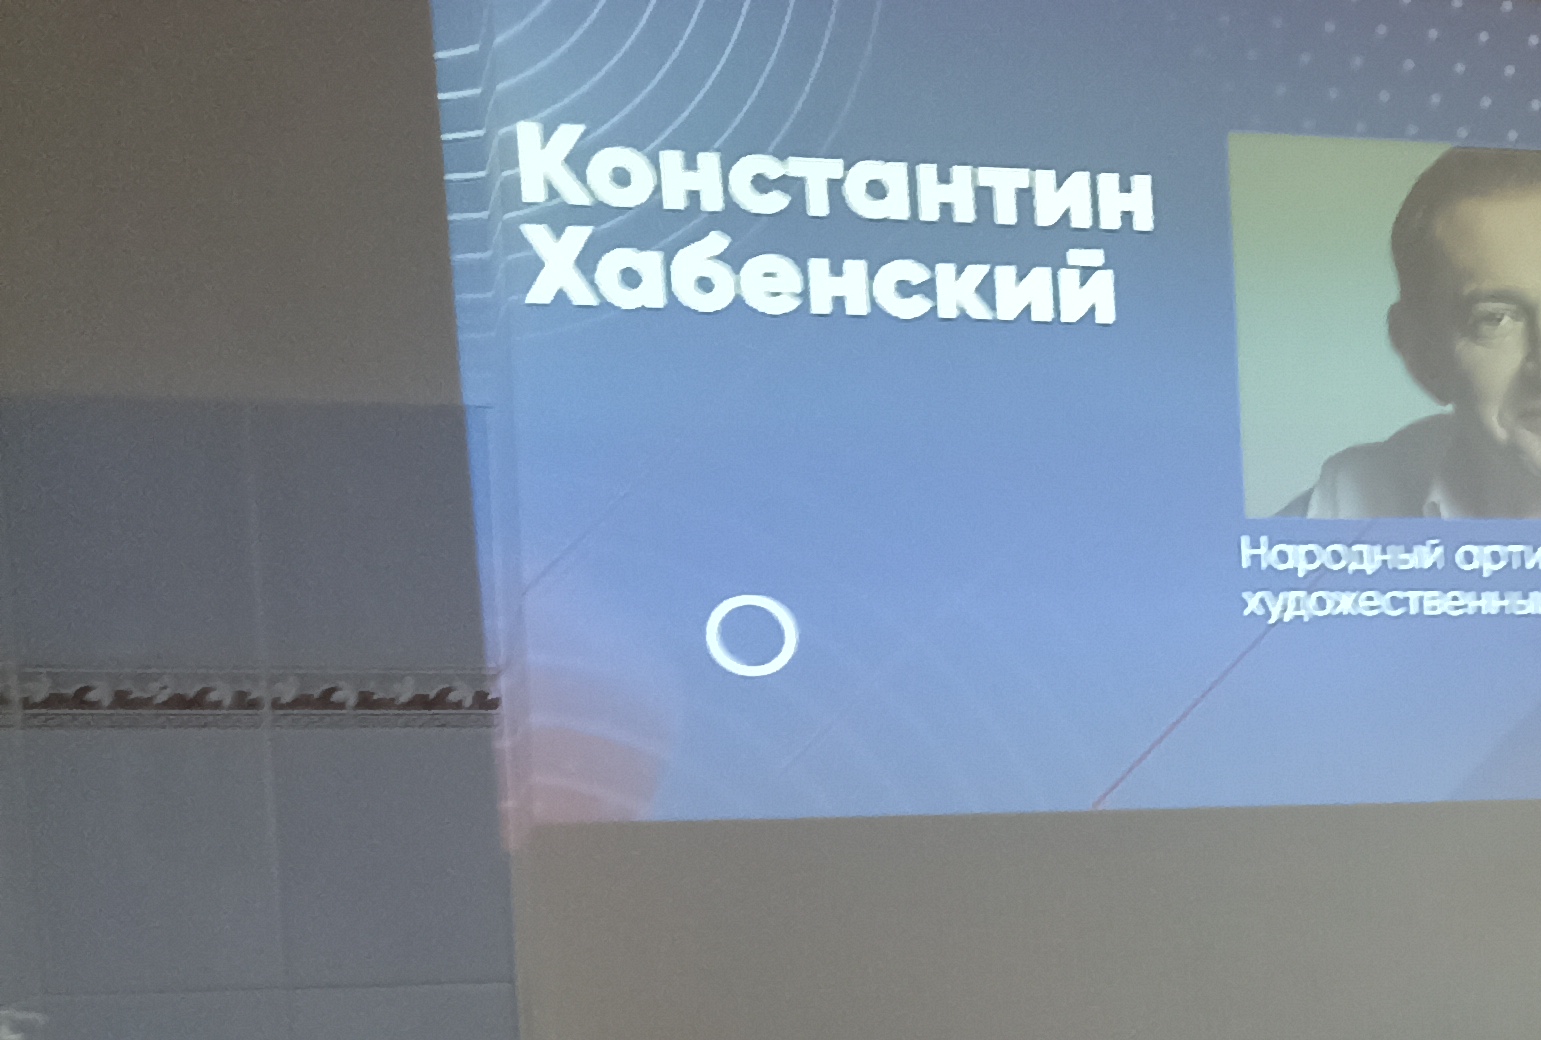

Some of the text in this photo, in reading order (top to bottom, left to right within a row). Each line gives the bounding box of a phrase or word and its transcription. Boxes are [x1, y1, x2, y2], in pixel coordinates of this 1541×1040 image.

[516, 121, 1155, 232] Константин
[519, 222, 1117, 325] Хабенский
[1240, 535, 1445, 577] Народный
